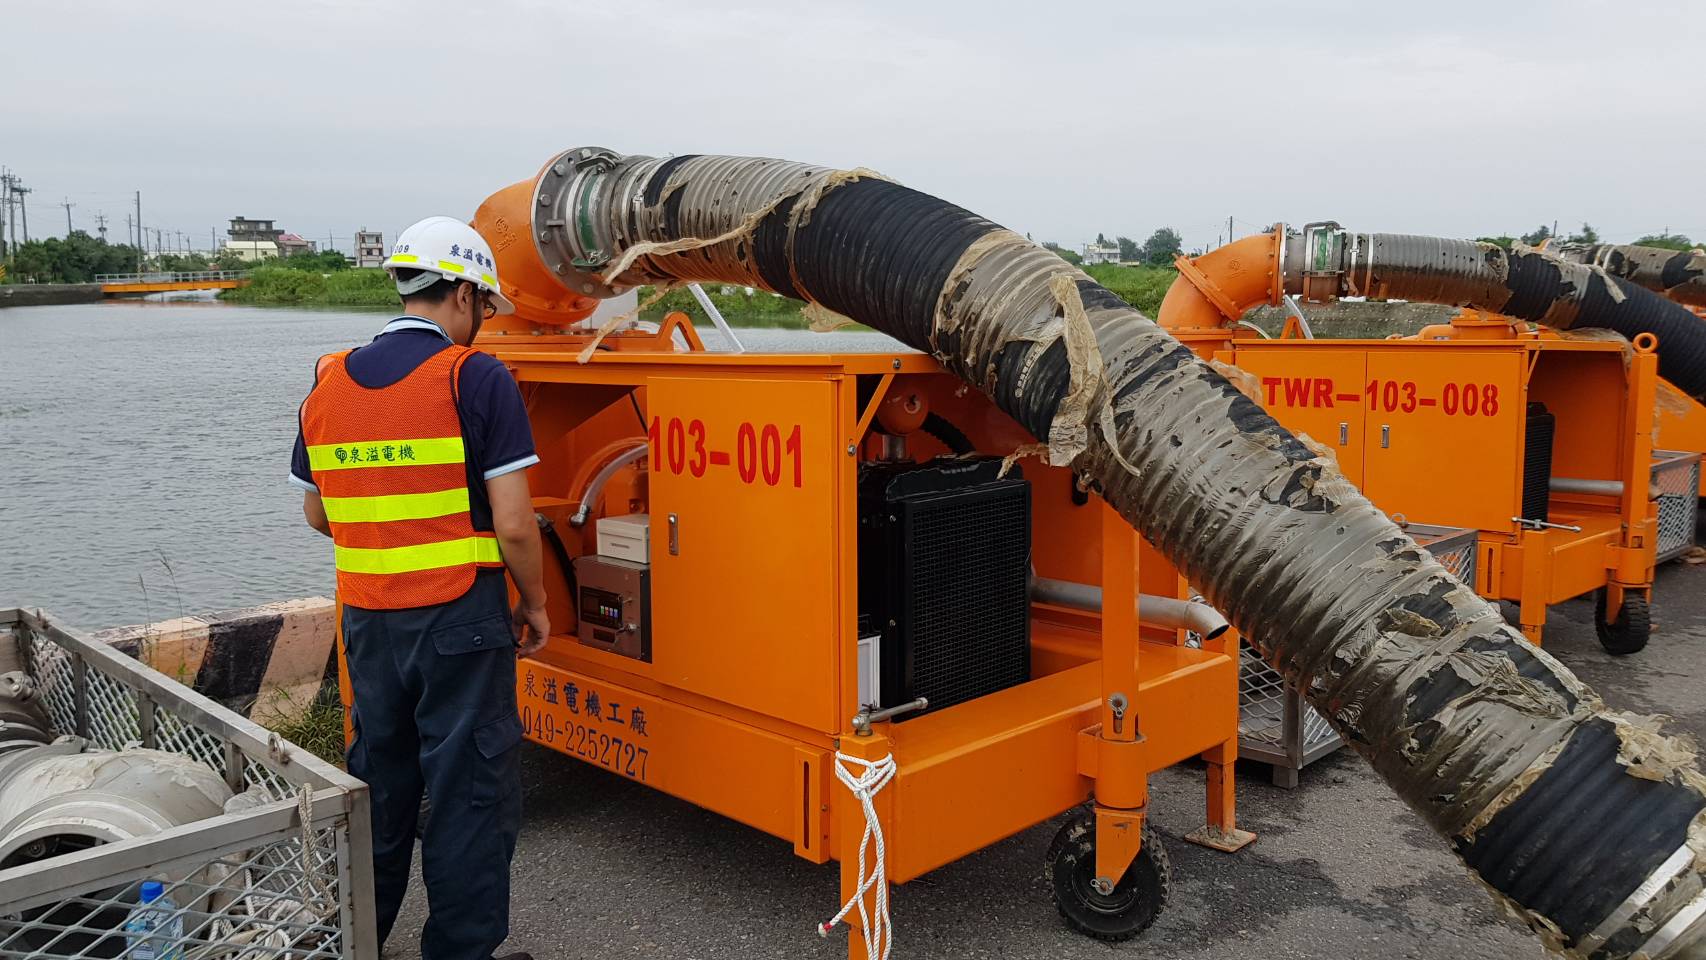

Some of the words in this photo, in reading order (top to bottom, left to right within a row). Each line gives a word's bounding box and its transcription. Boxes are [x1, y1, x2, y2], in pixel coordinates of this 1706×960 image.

[1262, 377, 1499, 416] TWR-103-008
[349, 444, 416, 464] 泉溢電機
[649, 415, 802, 488] 103-001
[523, 670, 648, 736] 泉溢電機工廠
[523, 706, 648, 780] 049-2252727
